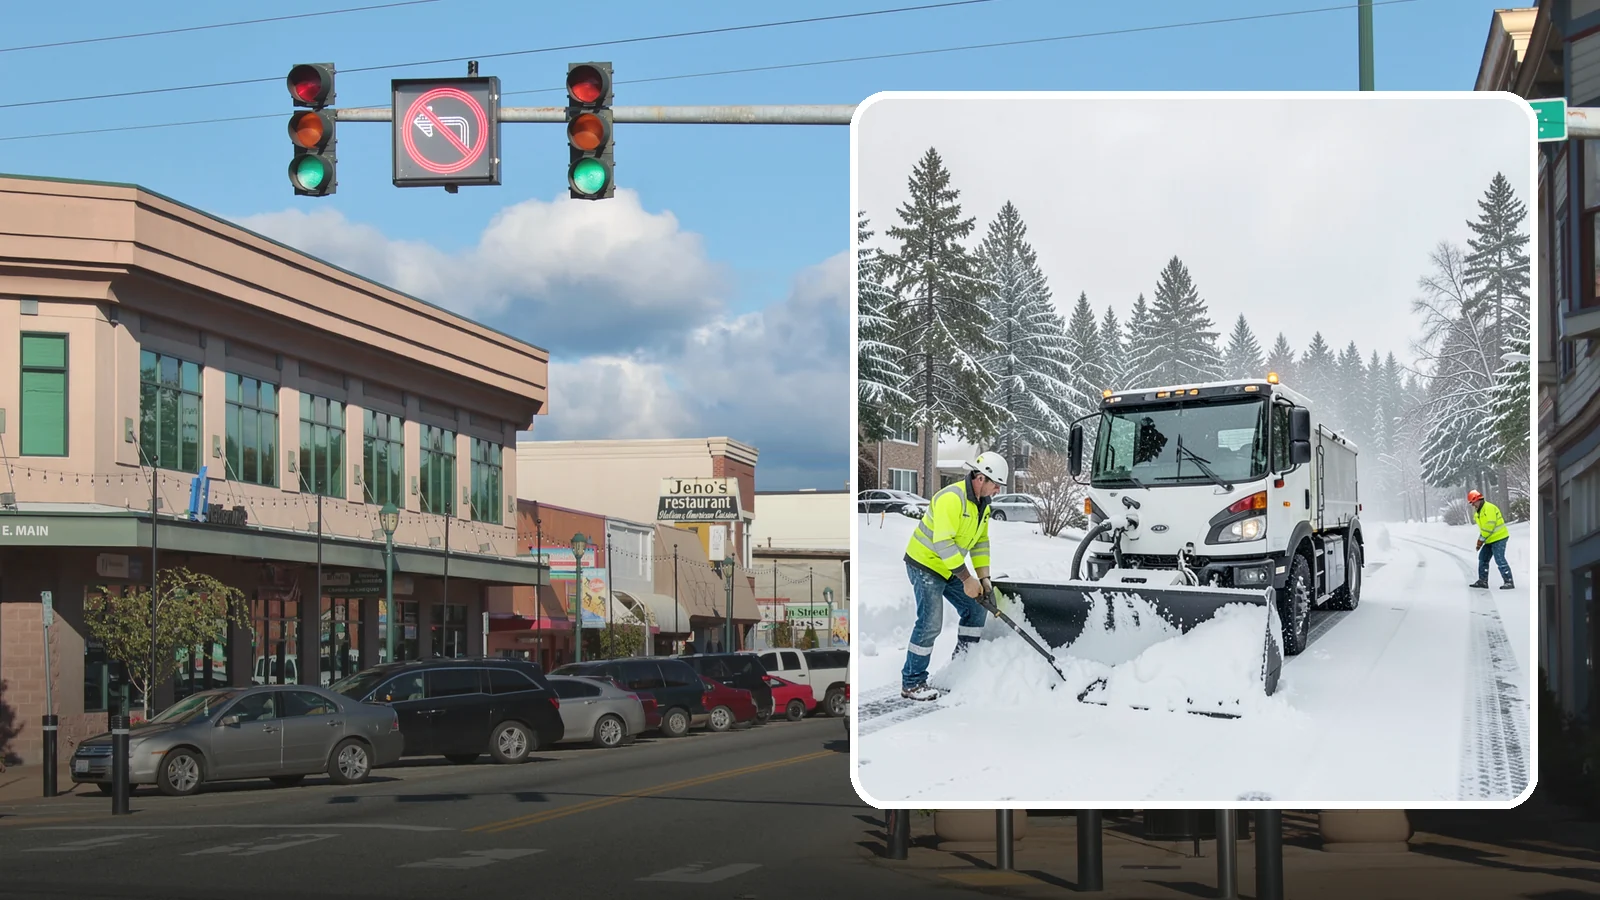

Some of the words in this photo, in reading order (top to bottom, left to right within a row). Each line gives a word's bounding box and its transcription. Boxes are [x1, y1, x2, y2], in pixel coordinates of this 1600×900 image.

[669, 480, 727, 494] Jeno's
[665, 496, 731, 509] restaurant
[658, 510, 681, 519] Italian
[686, 509, 714, 519] American
[715, 509, 737, 519] Cuisine
[2, 525, 13, 536] E.
[15, 525, 49, 536] MAIN
[797, 607, 829, 617] Street
